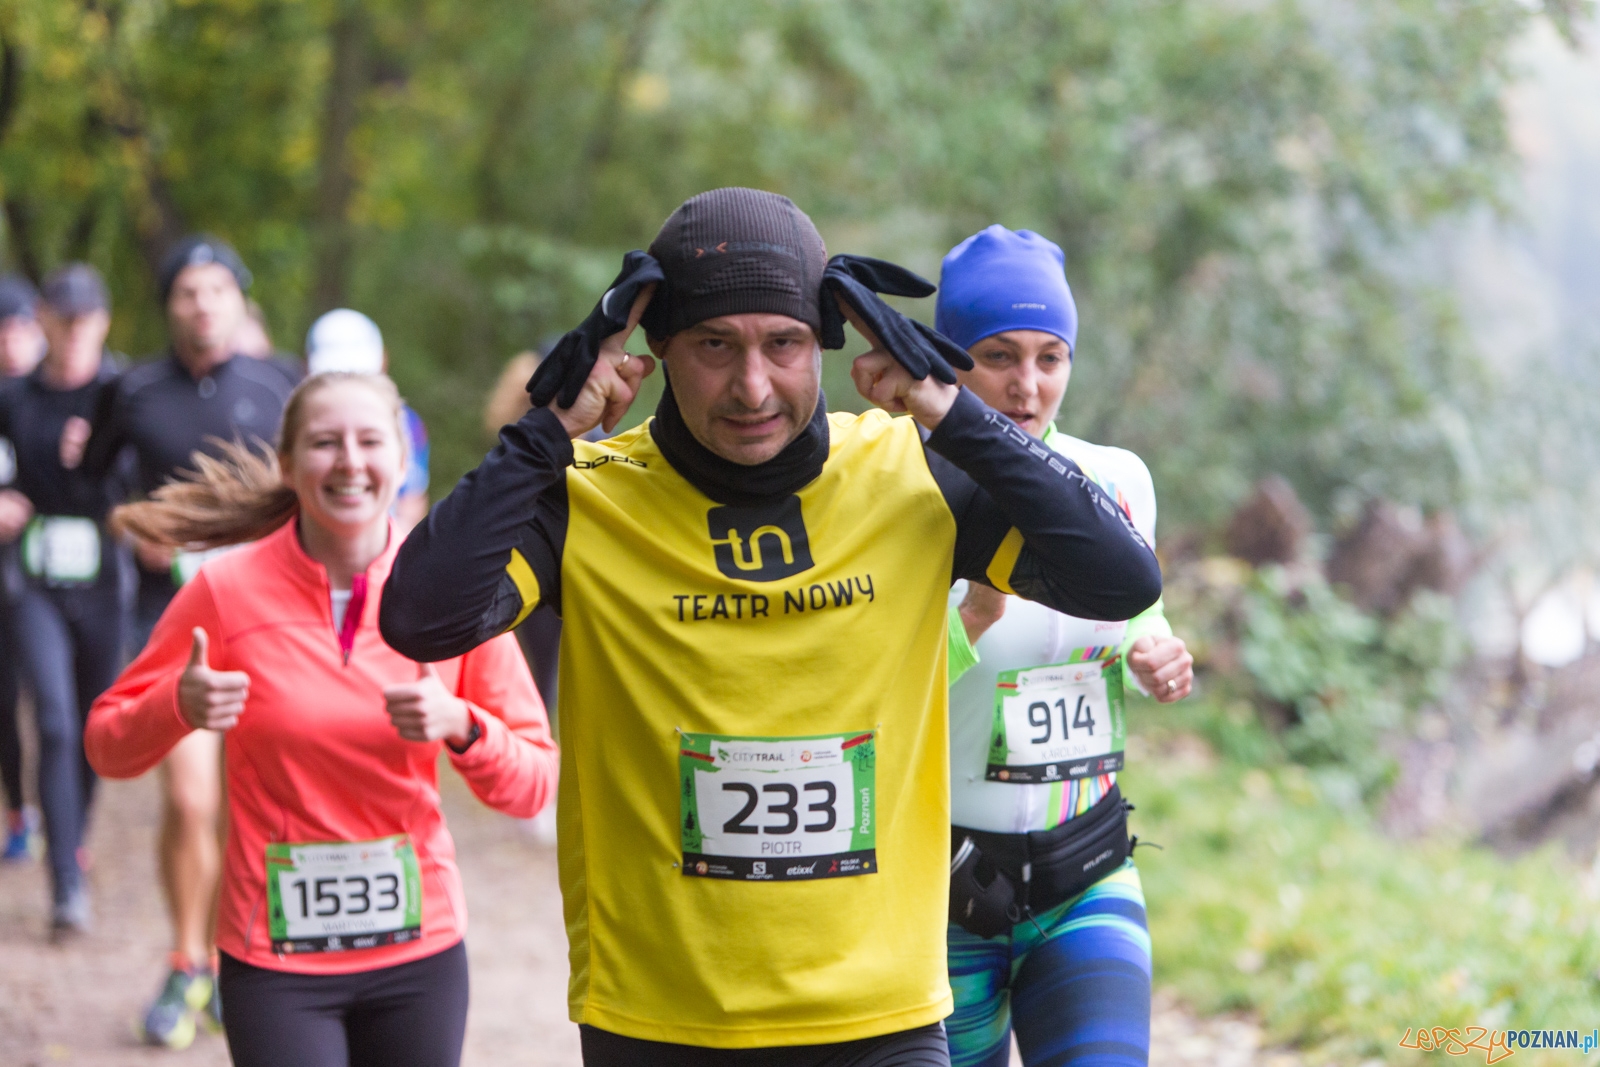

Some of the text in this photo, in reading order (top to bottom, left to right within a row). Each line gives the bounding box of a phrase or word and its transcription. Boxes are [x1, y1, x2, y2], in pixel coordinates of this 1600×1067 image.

[673, 574, 875, 622] TEATR NOWY
[1028, 694, 1096, 744] 914
[722, 780, 837, 835] 233
[859, 787, 870, 835] Poznań
[761, 841, 802, 855] PIOTR
[293, 873, 400, 919] 1533
